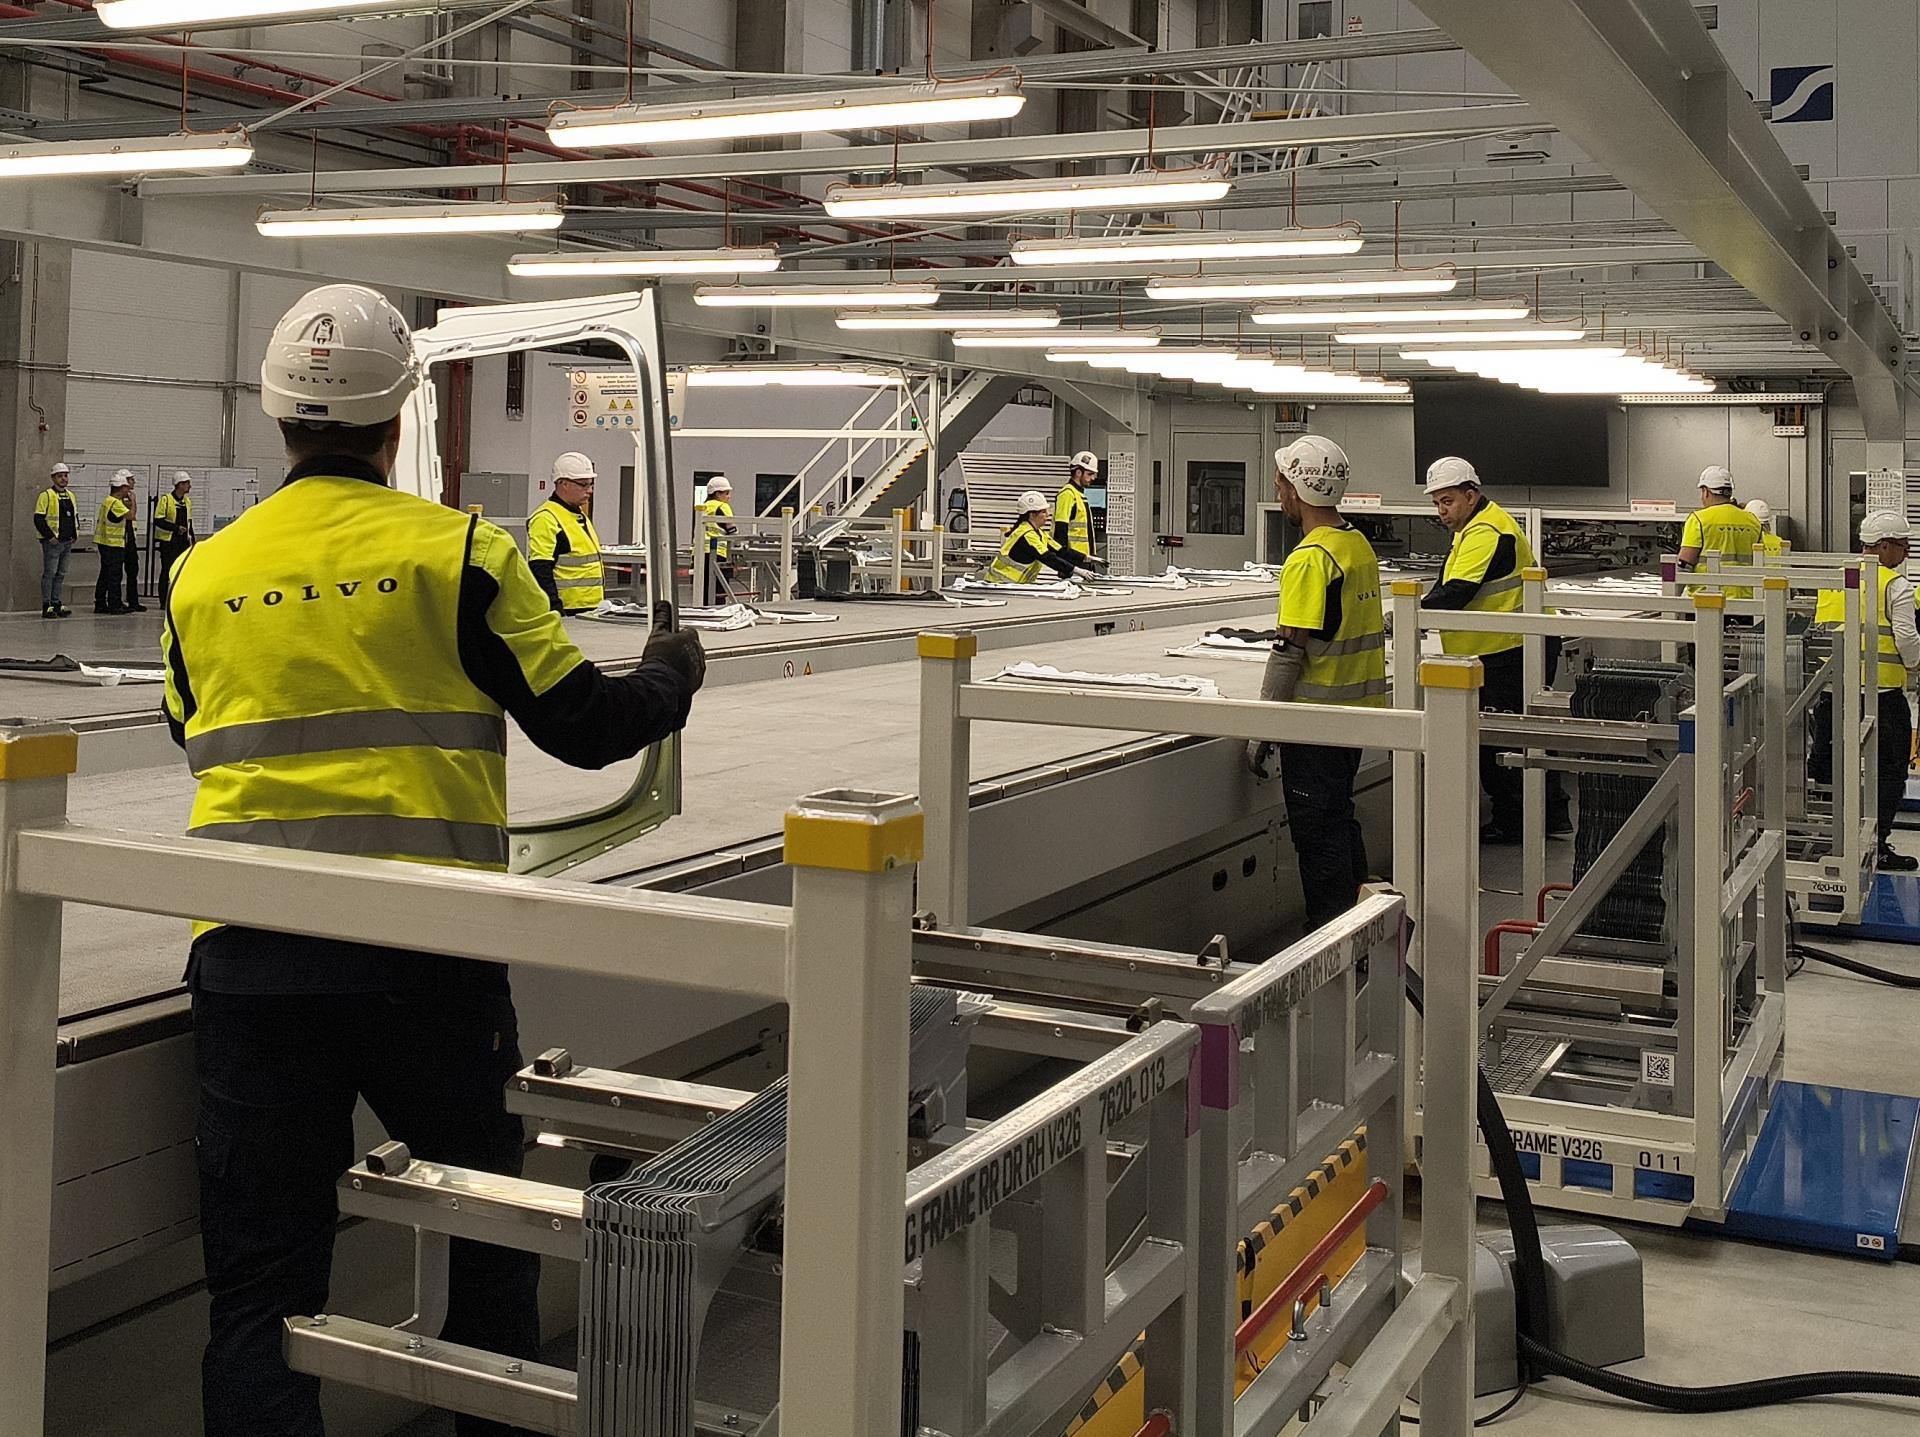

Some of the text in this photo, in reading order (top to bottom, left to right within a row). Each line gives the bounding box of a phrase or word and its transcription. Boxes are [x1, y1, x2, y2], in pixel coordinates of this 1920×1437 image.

[287, 373, 348, 385] VOLVO
[223, 577, 399, 613] VOLVO
[1561, 1135, 1603, 1161] V326
[919, 1173, 977, 1253] FRAME
[978, 1158, 1000, 1216] RR
[1002, 1143, 1024, 1198] DR
[1025, 1127, 1046, 1182] RH
[1049, 1105, 1082, 1165] V326
